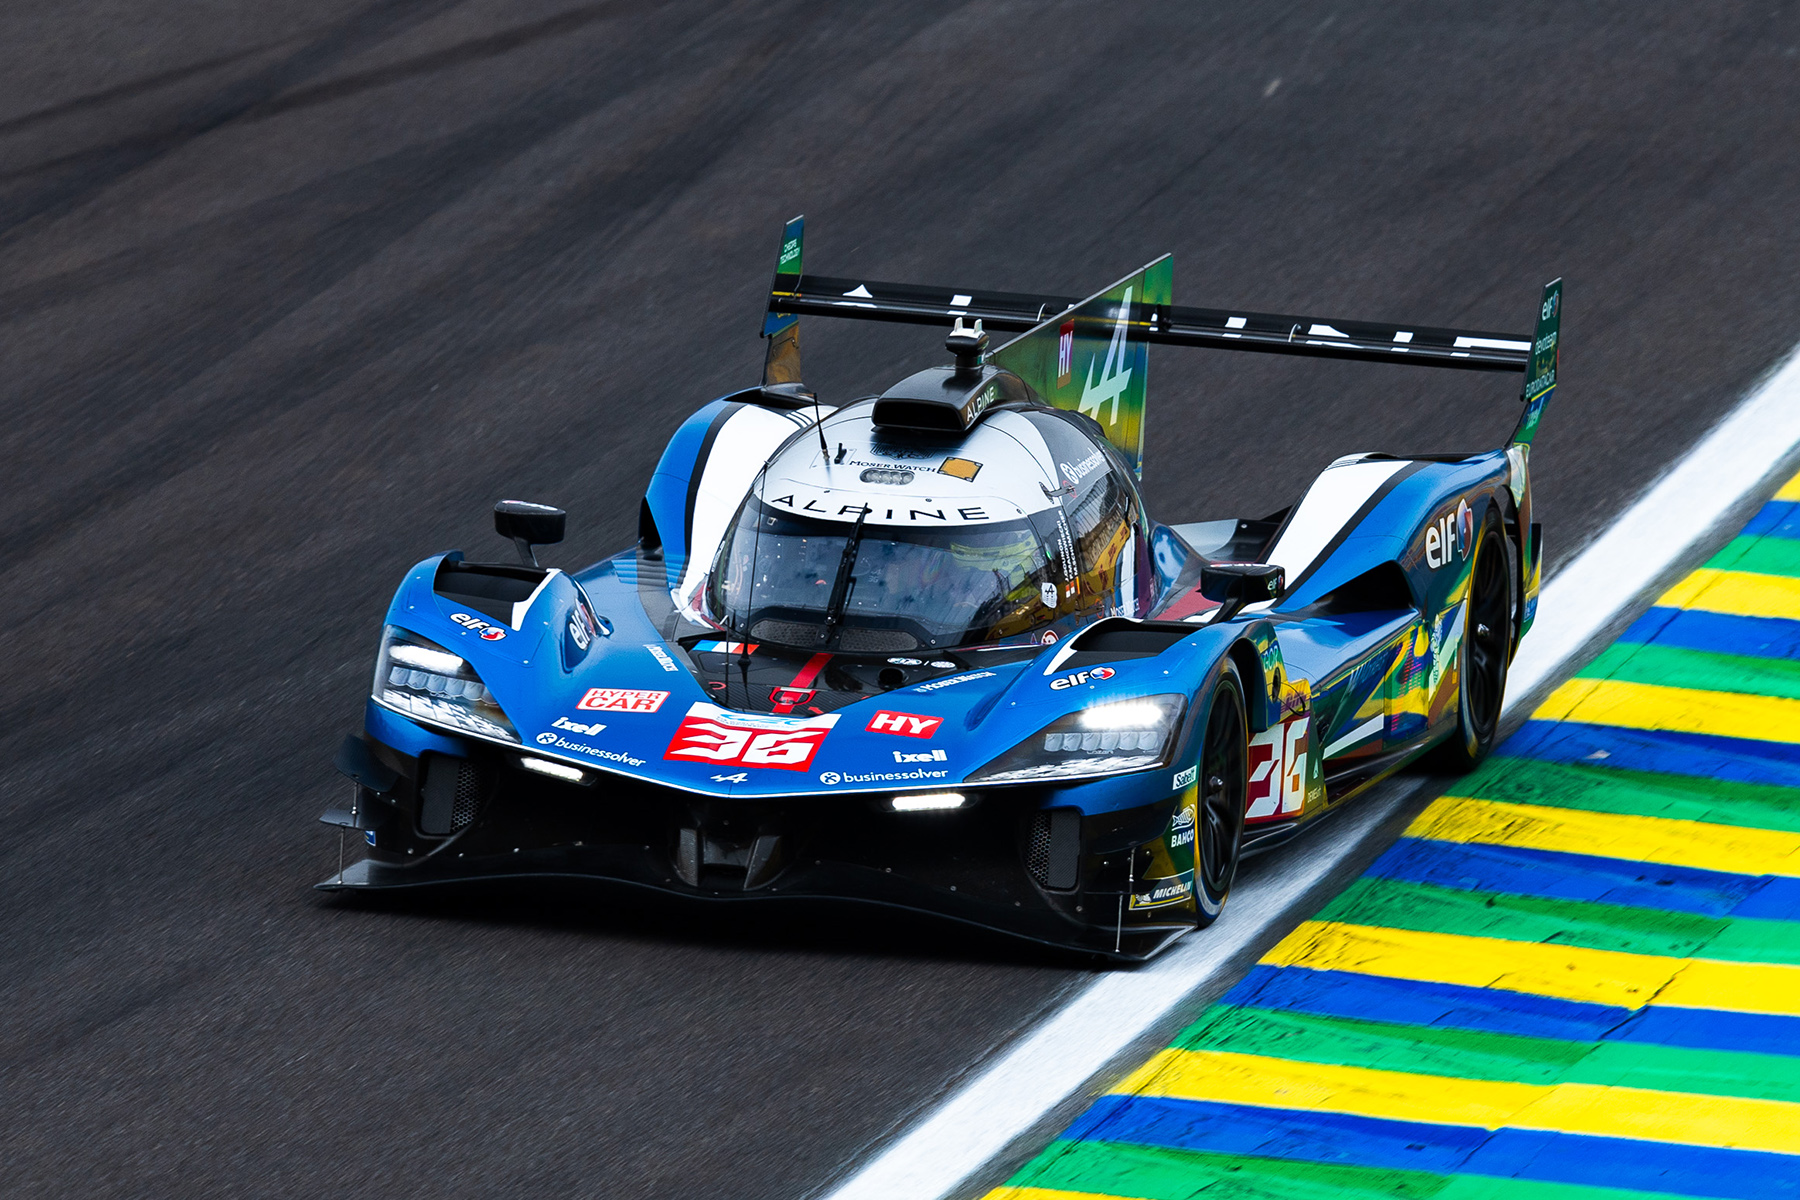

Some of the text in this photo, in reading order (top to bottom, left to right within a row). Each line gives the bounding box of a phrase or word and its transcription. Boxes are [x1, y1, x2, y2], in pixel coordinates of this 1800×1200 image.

[1542, 297, 1552, 321] elf
[1058, 330, 1073, 378] HY
[967, 386, 994, 421] ALPINE
[771, 494, 989, 521] ALPINE
[1425, 512, 1456, 569] elf
[450, 612, 485, 631] elf
[569, 609, 591, 649] elf
[1050, 672, 1090, 690] elf
[585, 697, 656, 711] CAR
[592, 689, 661, 700] HYPER
[551, 716, 607, 736] ixell
[870, 713, 940, 735] HY
[555, 736, 646, 767] businessolver
[670, 721, 824, 764] 36
[893, 749, 948, 763] ixell
[843, 768, 949, 783] businessolver
[1245, 717, 1310, 818] 36
[1171, 828, 1194, 848] BAHCO
[1153, 881, 1192, 899] MICHELIN
